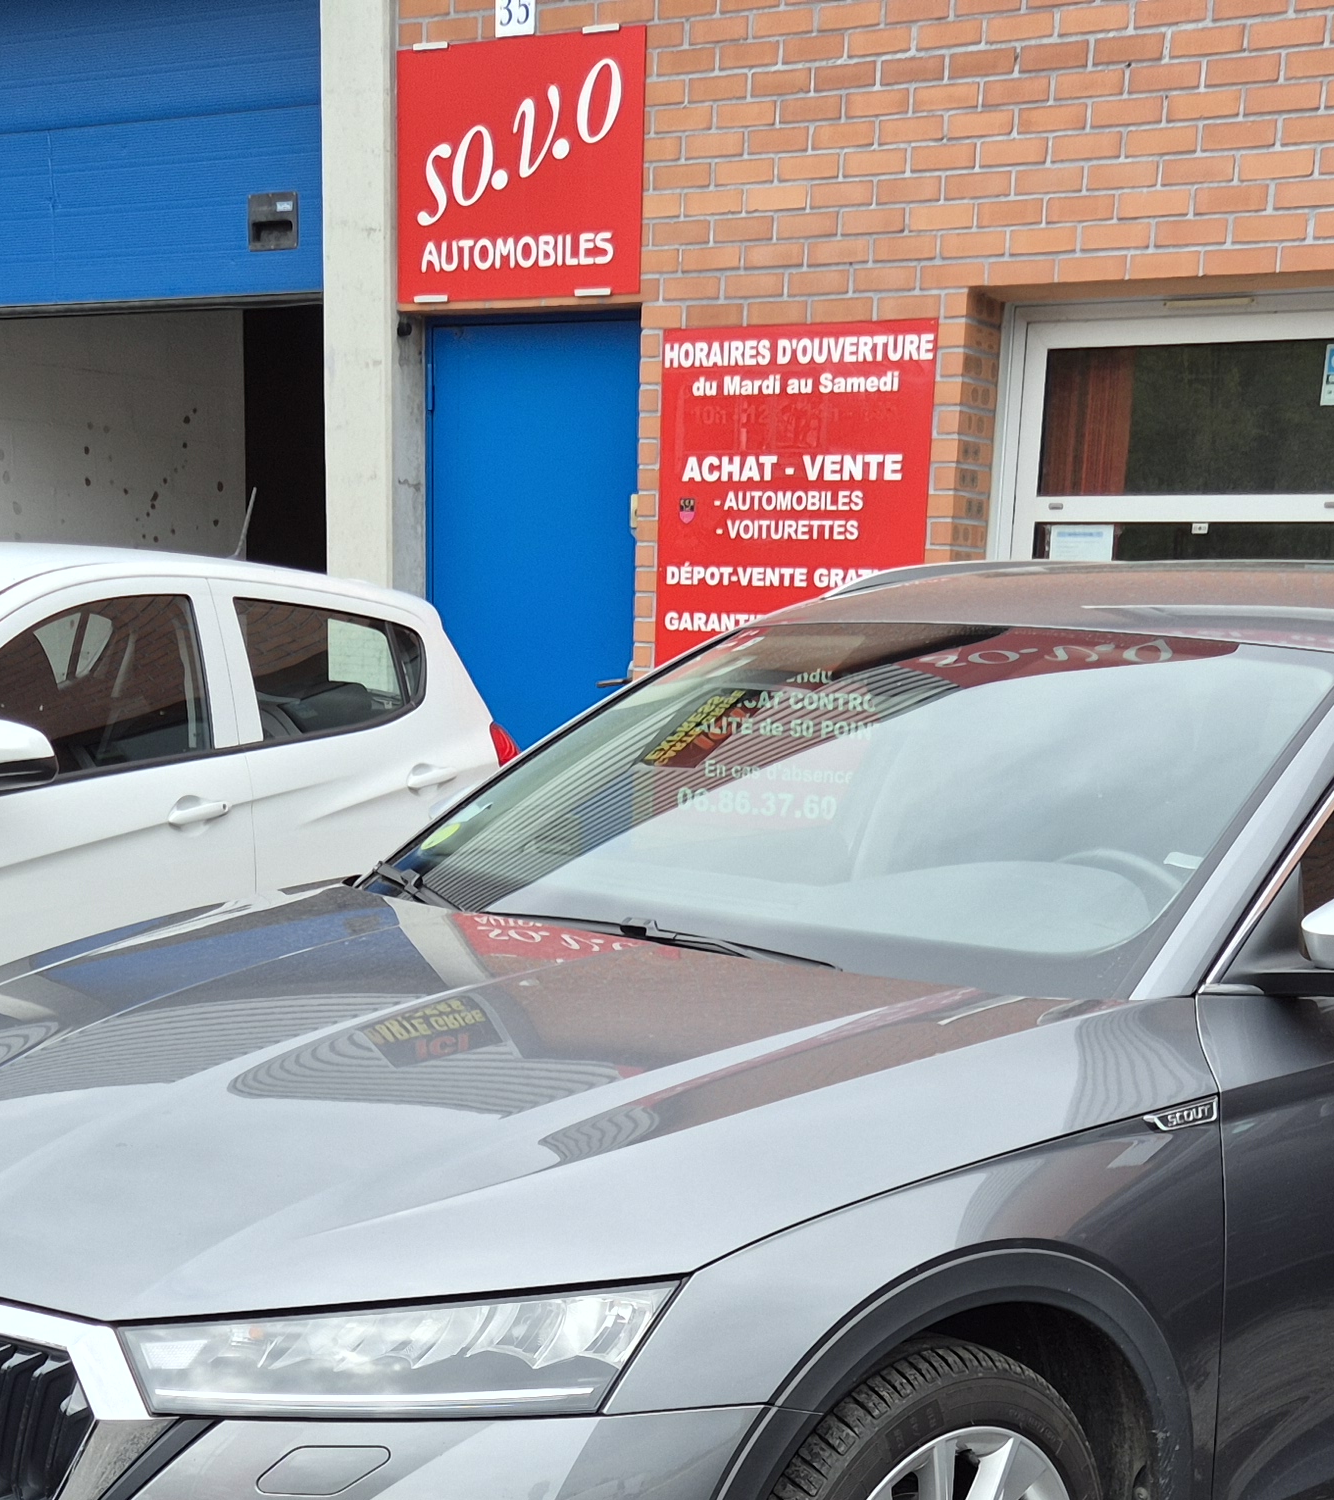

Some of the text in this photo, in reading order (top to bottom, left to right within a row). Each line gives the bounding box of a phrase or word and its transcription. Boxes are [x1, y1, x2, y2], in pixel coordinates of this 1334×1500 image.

[499, 0, 531, 27] 35
[420, 231, 615, 274] AUTOMOBILES
[664, 333, 935, 369] HORAIRES D'OUVERTURE
[692, 371, 900, 397] du Mardi au Samedi
[681, 454, 779, 483] ACHAT
[802, 453, 904, 482] VENTE
[666, 562, 808, 587] DÉPOT-VENTE
[759, 718, 784, 737] de
[789, 719, 815, 738] 50
[704, 759, 726, 778] En
[1167, 1104, 1211, 1127] SCOUT
